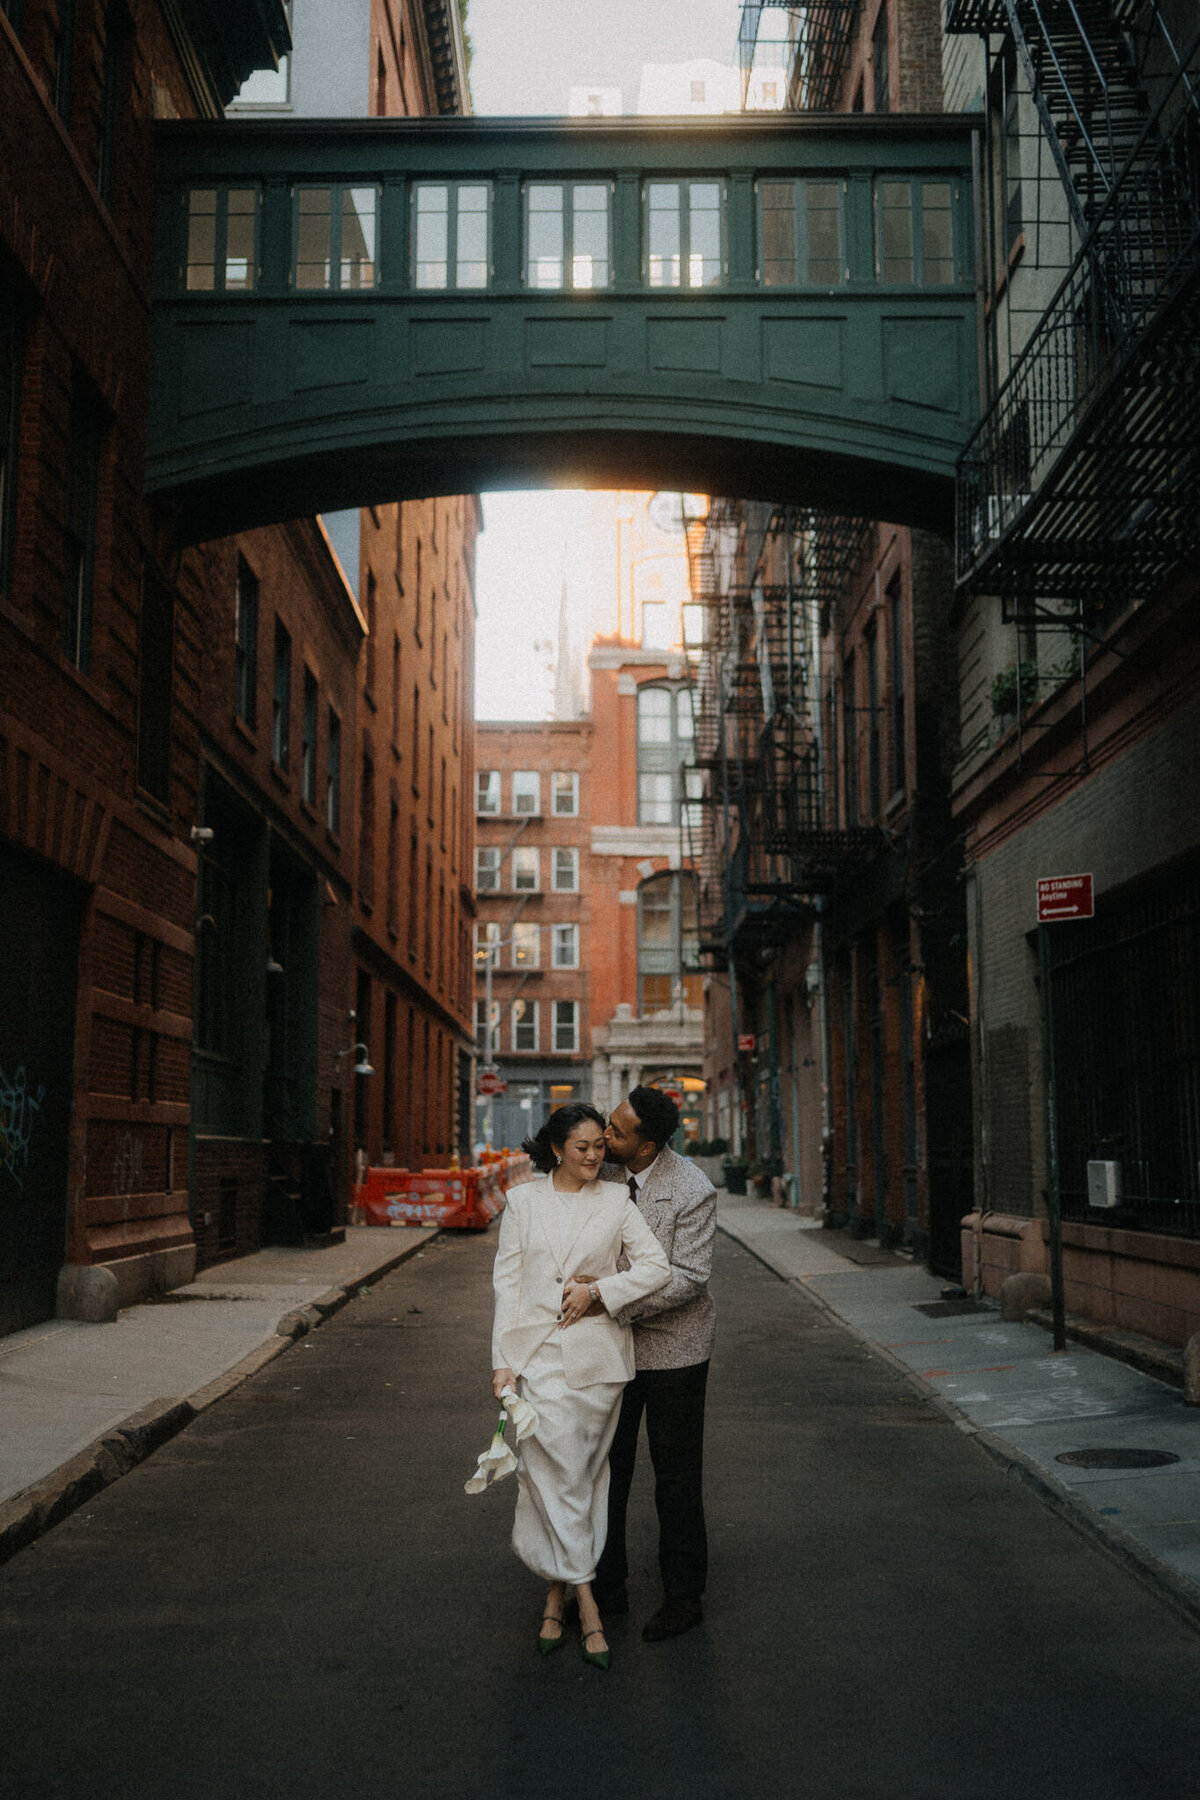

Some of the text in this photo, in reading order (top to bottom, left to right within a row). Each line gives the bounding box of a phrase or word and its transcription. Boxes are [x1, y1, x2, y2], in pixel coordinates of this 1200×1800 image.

[1040, 880, 1083, 891] NO STANDING
[1041, 892, 1067, 901] Anytime
